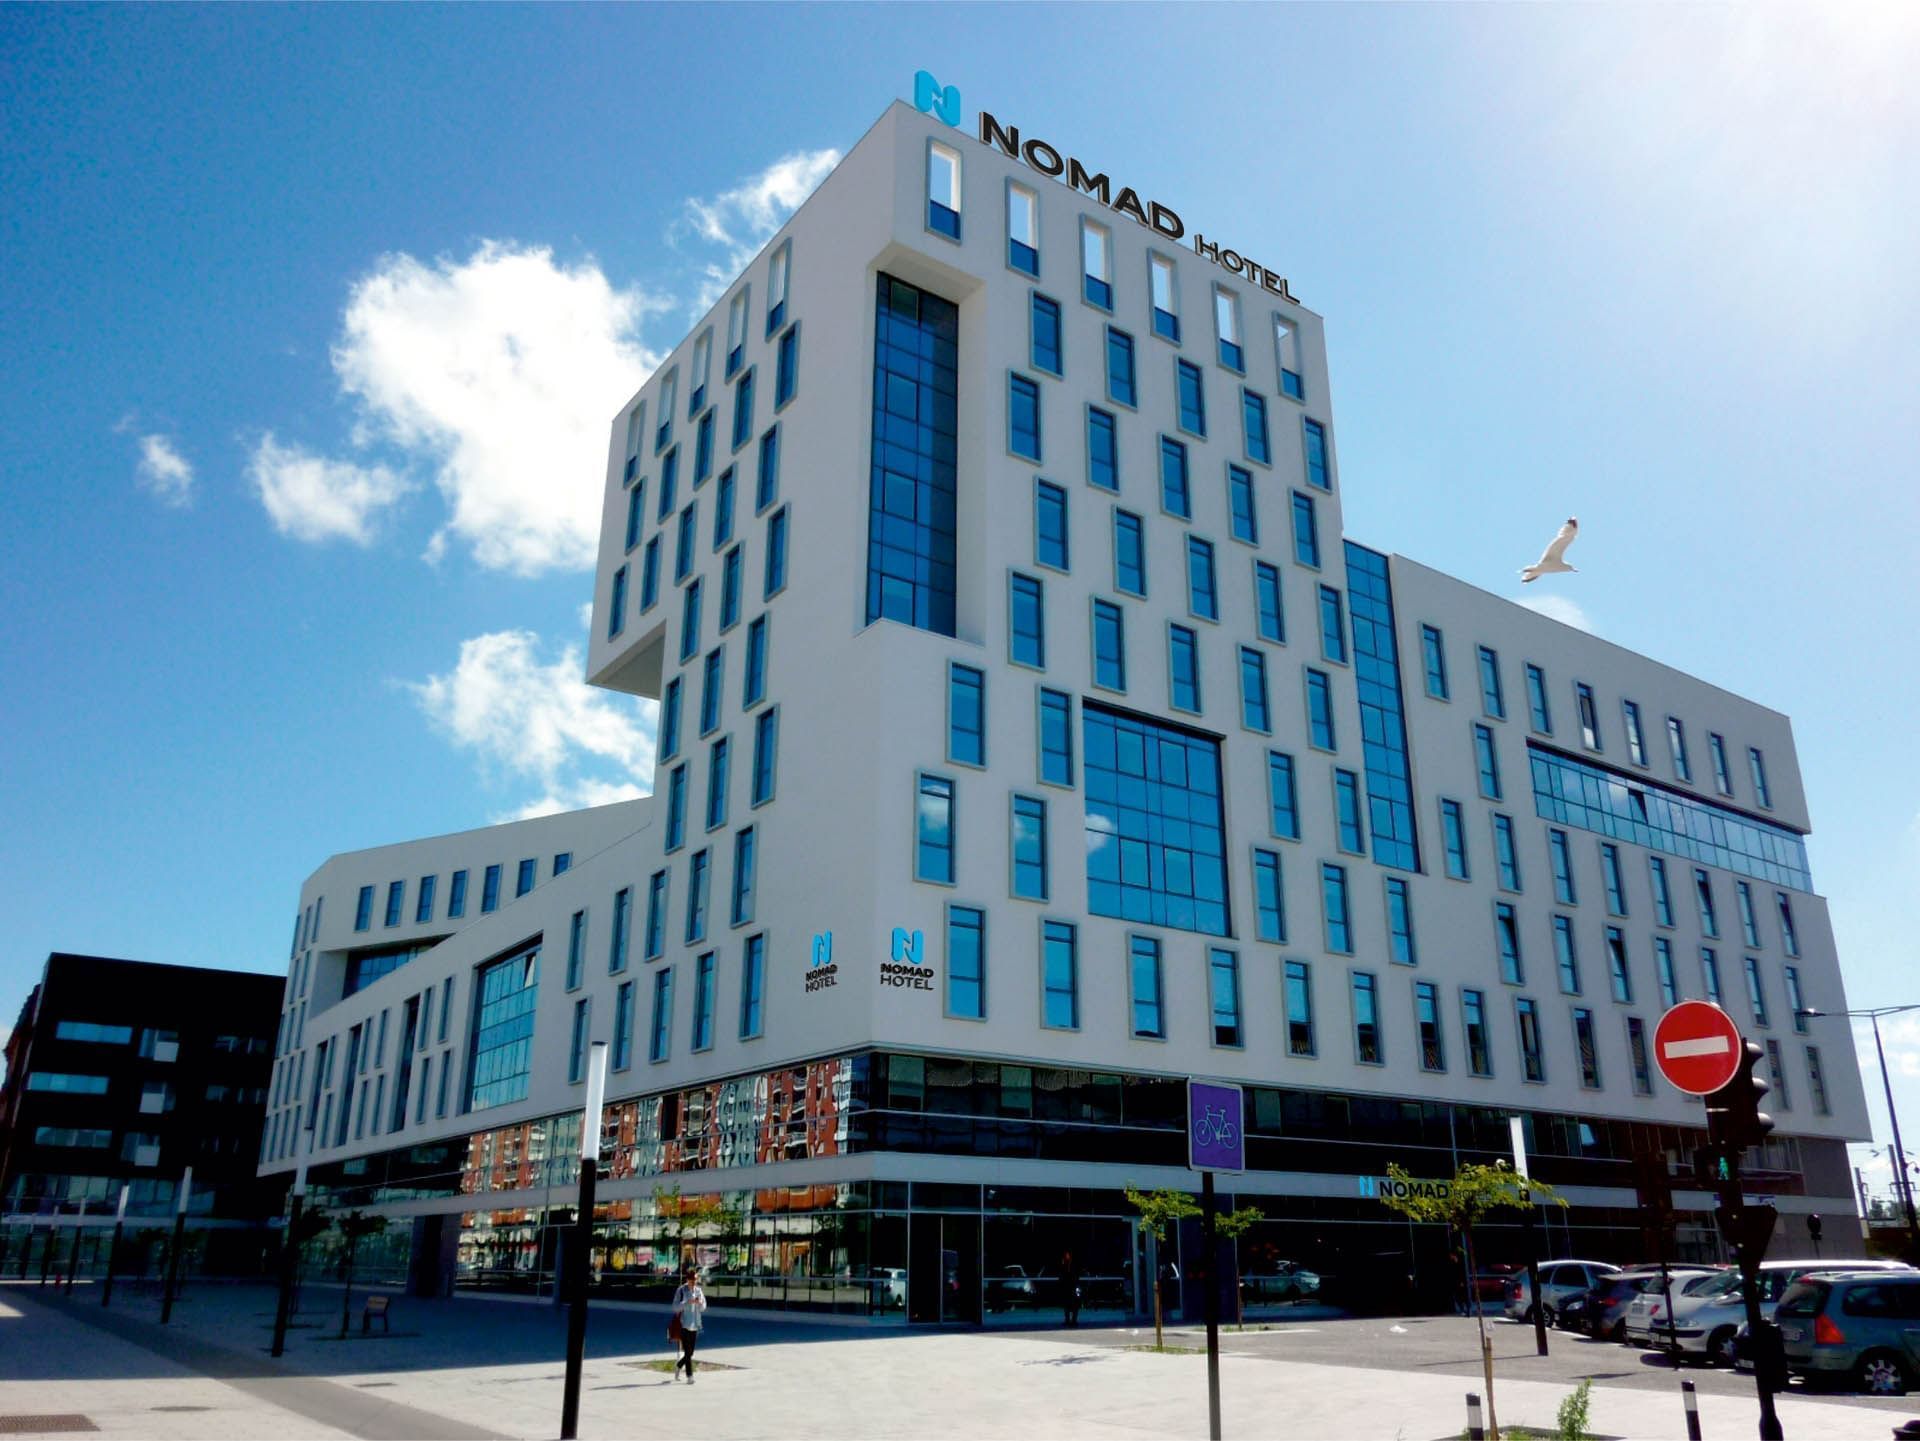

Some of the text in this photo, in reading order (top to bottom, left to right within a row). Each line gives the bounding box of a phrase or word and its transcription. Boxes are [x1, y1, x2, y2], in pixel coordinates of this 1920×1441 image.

[978, 111, 1185, 241] NOMAD
[1194, 234, 1301, 305] HOTEL
[806, 964, 838, 982] NOMAD
[880, 963, 934, 978] NOMAD
[805, 975, 838, 993] HOTEL
[880, 974, 934, 990] HOTEL
[1379, 1181, 1449, 1199] NOMAD
